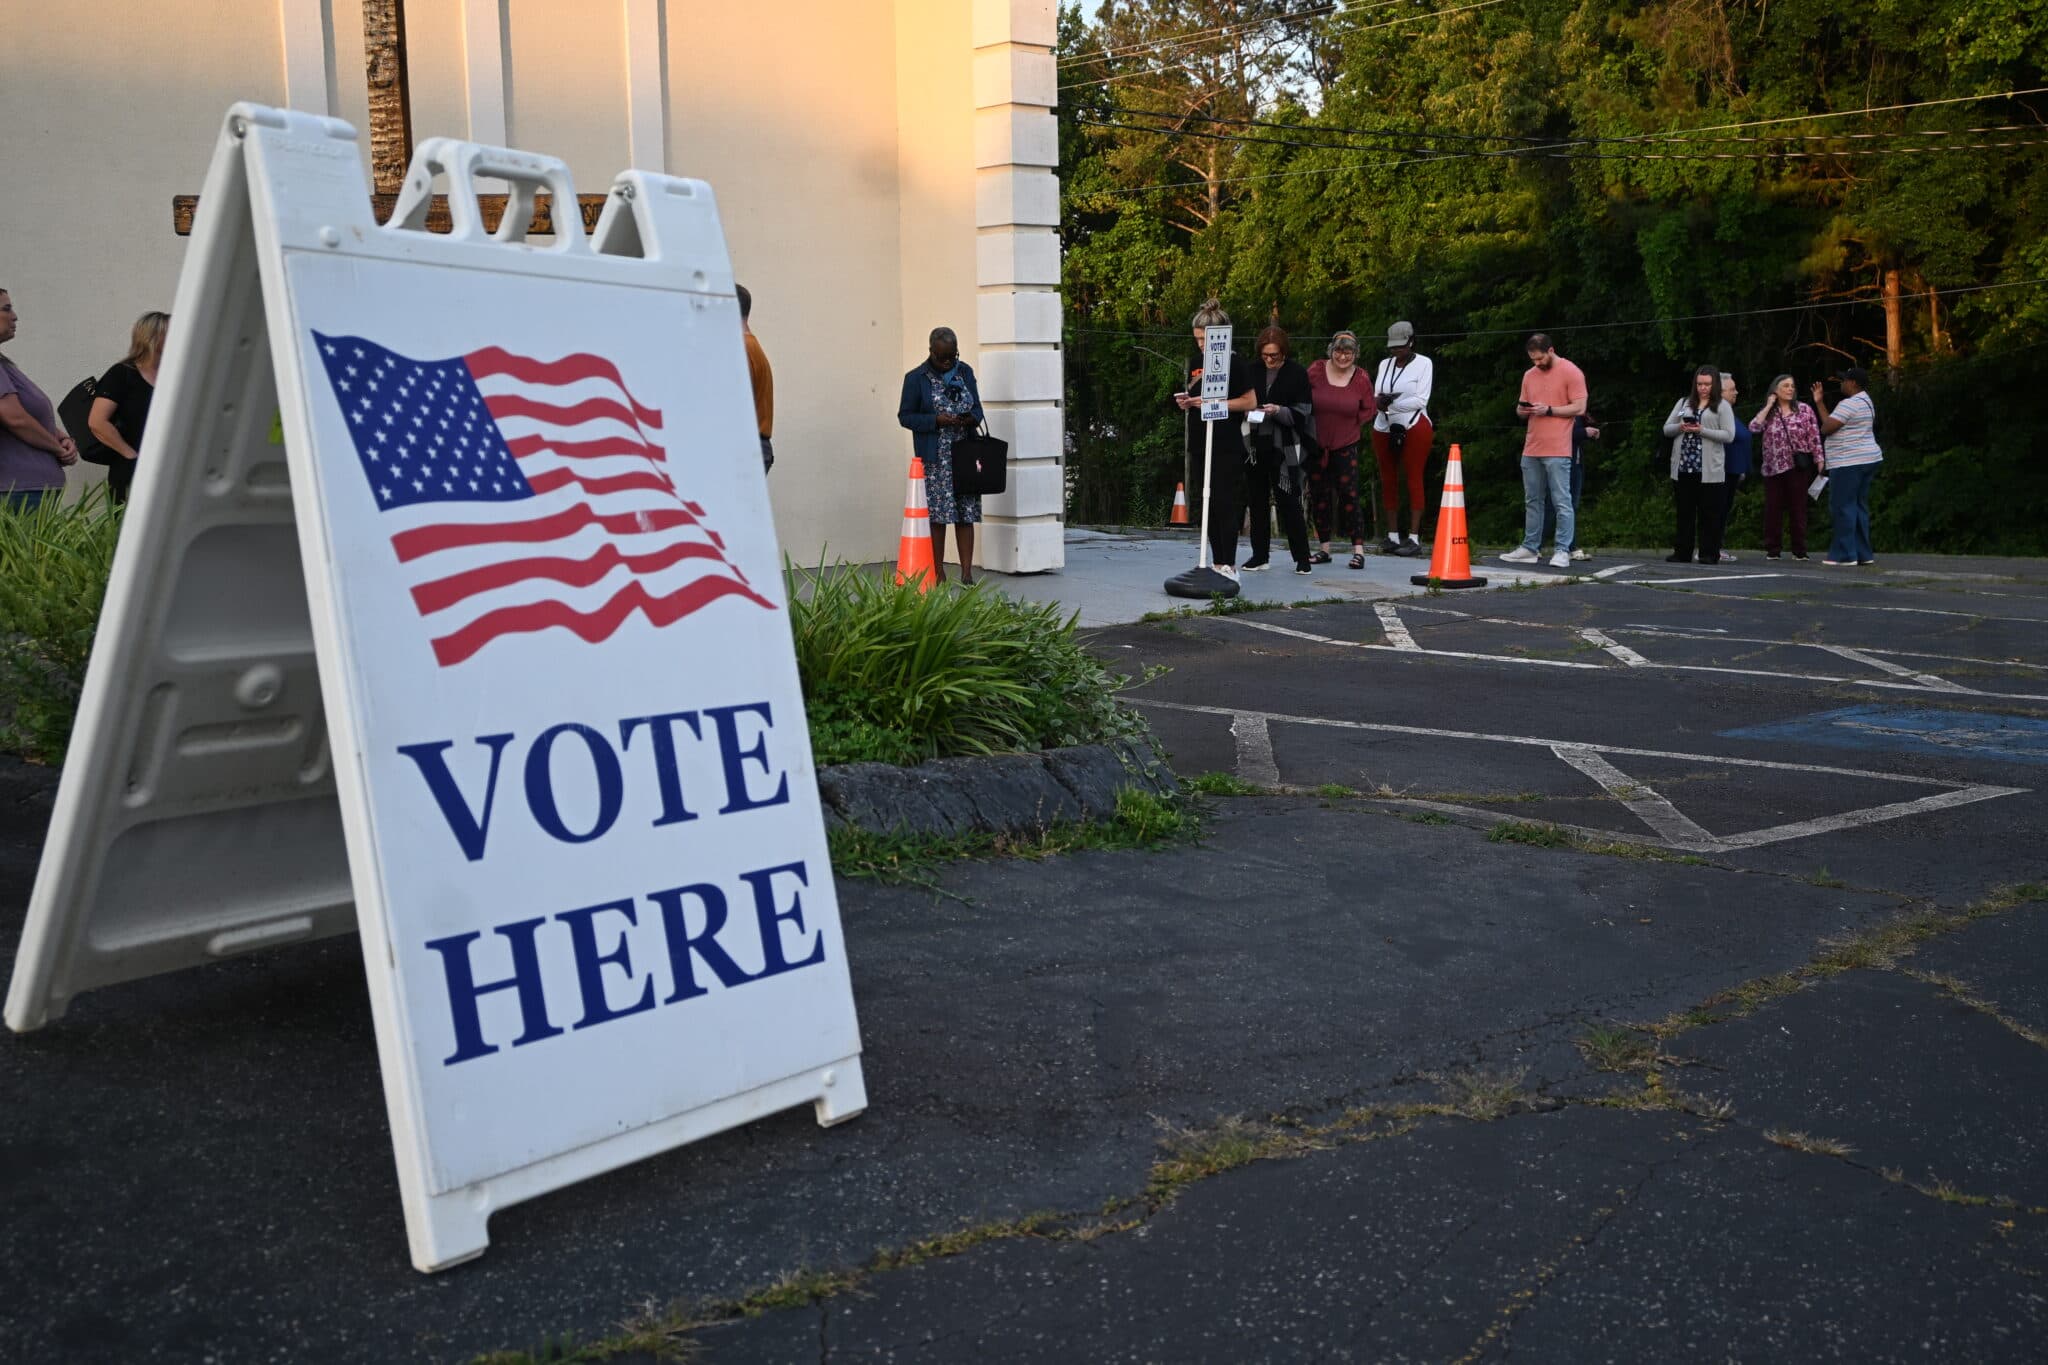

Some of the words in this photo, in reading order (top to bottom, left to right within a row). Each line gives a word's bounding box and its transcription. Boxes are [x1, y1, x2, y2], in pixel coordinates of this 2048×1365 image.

[1206, 374, 1227, 383] PARKING
[1210, 342, 1226, 351] VOTER
[397, 701, 790, 862] VOTE
[424, 861, 825, 1066] HERE
